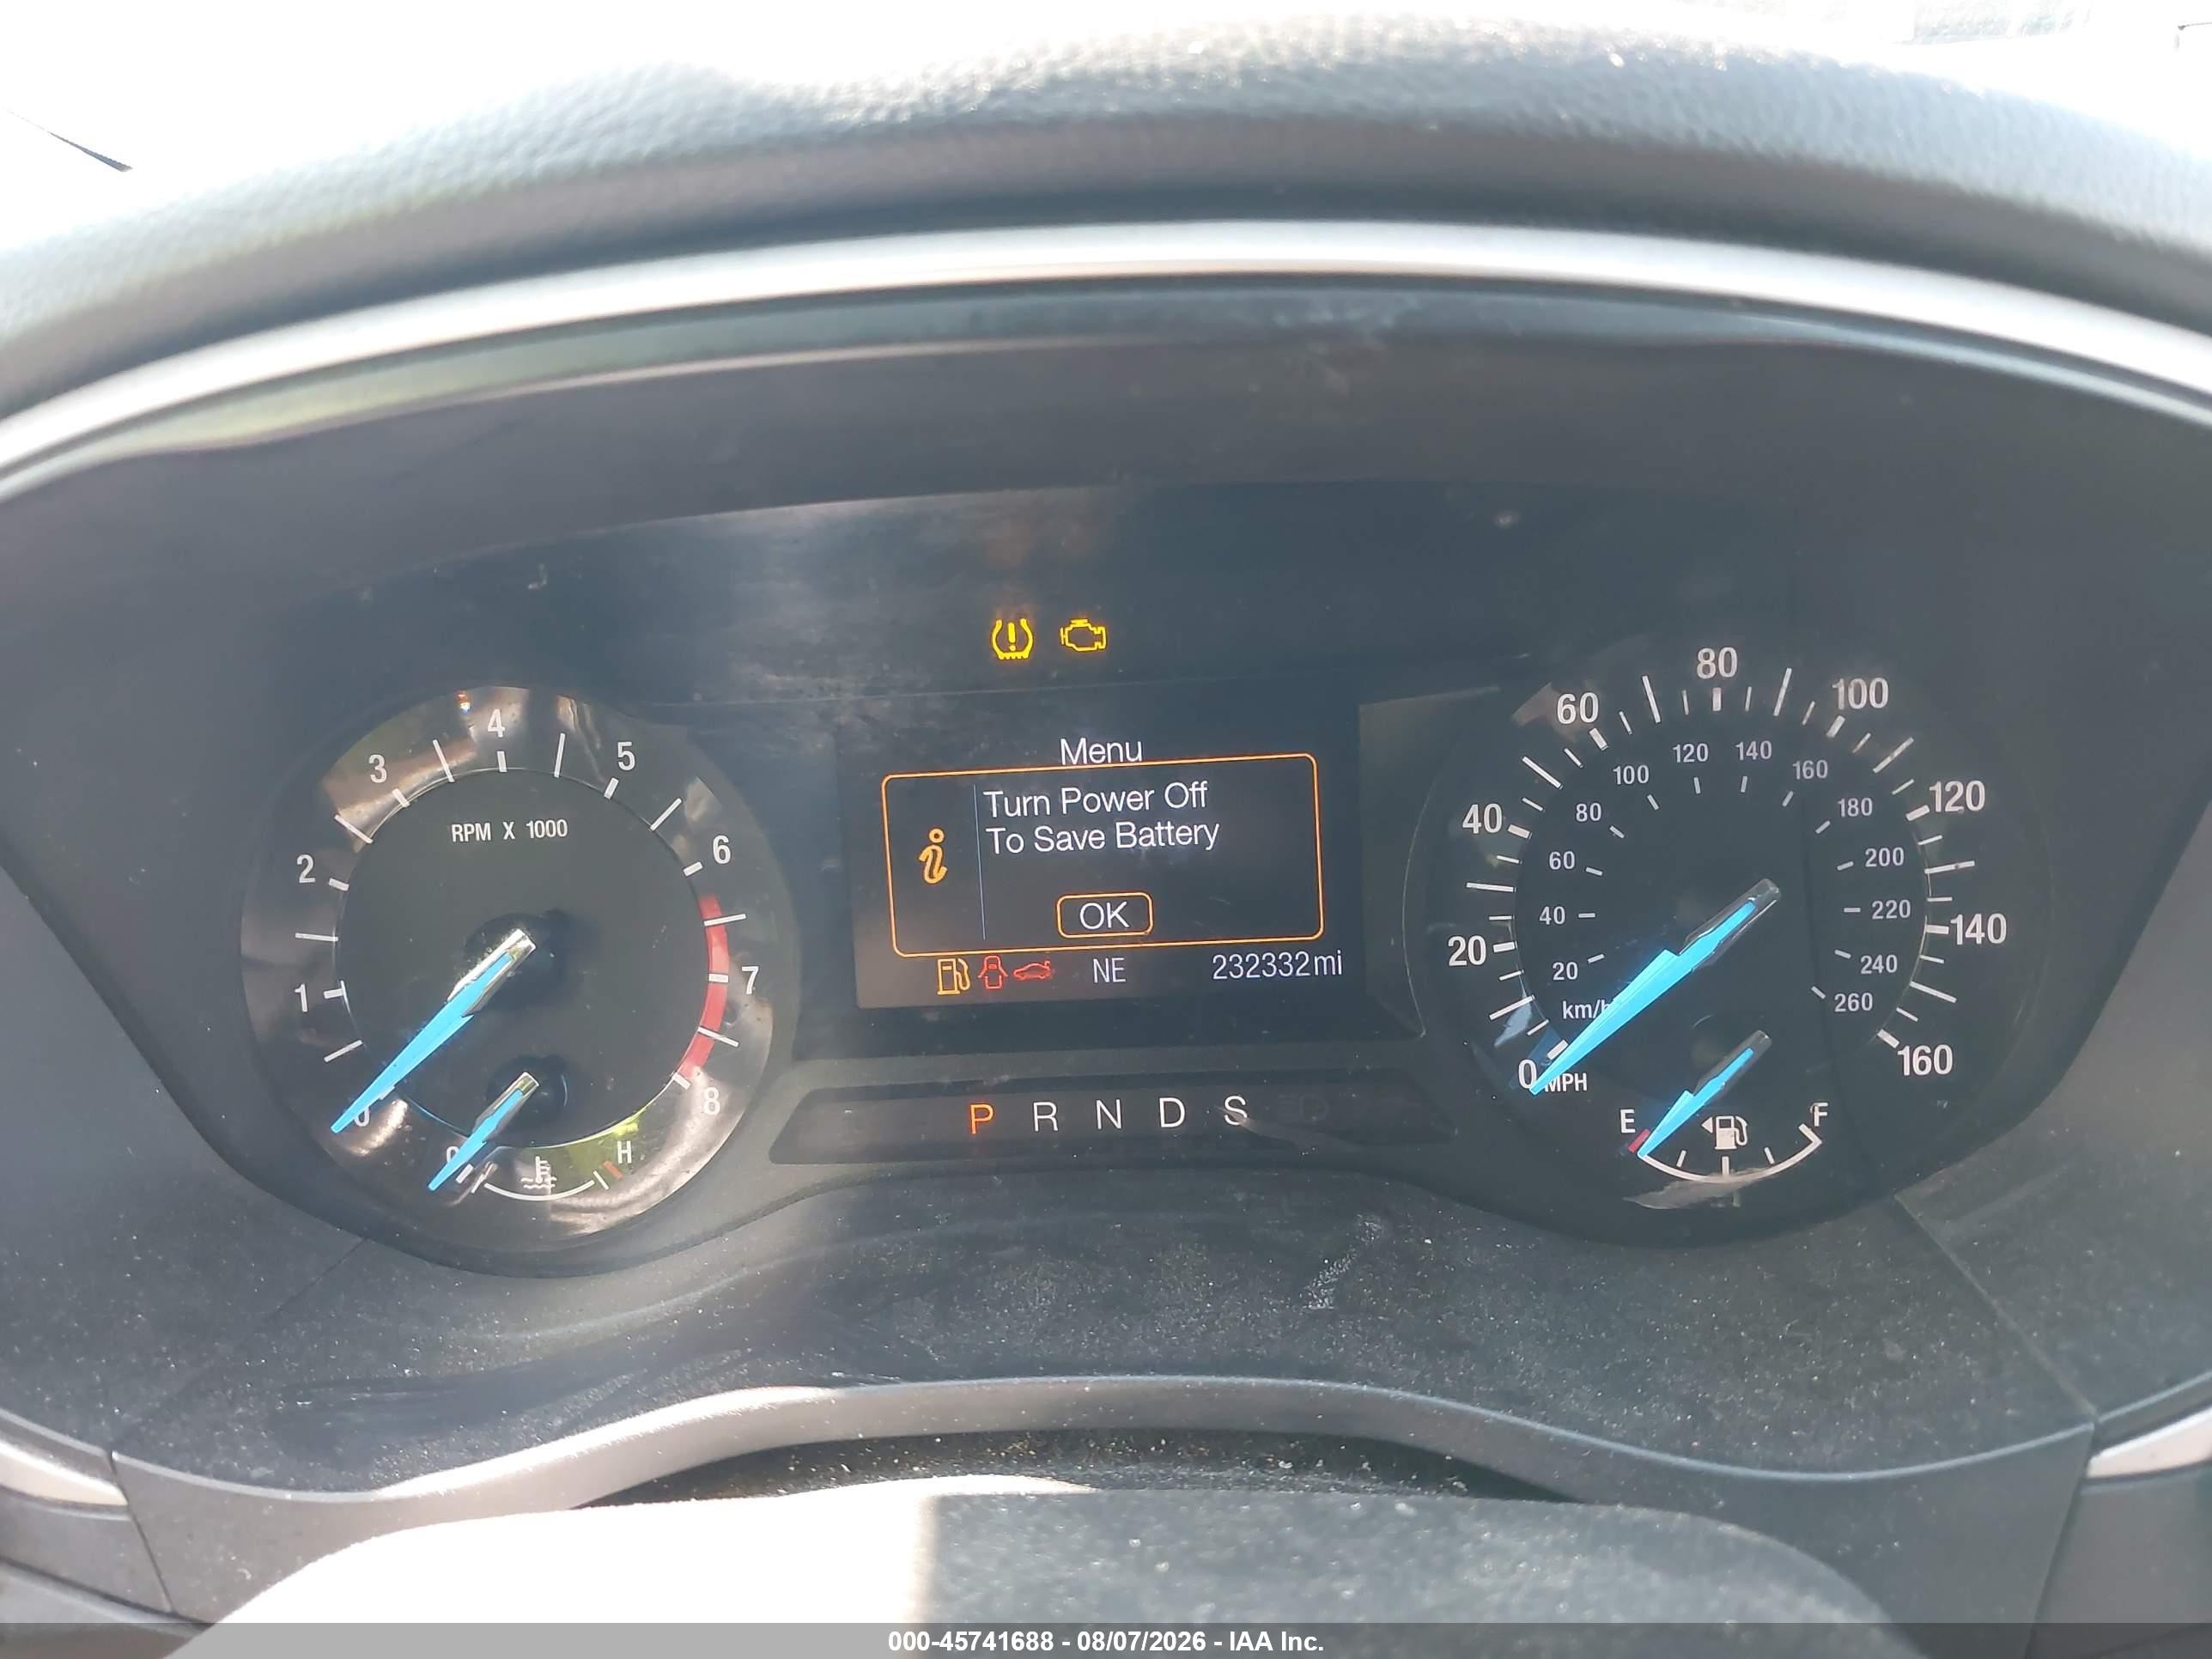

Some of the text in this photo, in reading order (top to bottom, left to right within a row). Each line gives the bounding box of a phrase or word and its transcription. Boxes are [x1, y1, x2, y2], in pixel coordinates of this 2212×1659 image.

[1697, 647, 1738, 679] 80
[1832, 678, 1889, 709] 100
[487, 708, 506, 738] 4
[1557, 692, 1599, 725] 60
[617, 741, 635, 771] 5
[1060, 737, 1142, 764] Menu
[1673, 743, 1709, 763] 120
[1735, 740, 1772, 761] 140
[368, 754, 387, 783] 3
[1613, 764, 1650, 785] 100
[1792, 759, 1828, 780] 160
[982, 780, 1208, 817] Turn Power Off
[1838, 797, 1873, 817] 180
[1928, 780, 1985, 811] 120
[1462, 803, 1503, 834] 40
[1576, 802, 1601, 822] 80
[452, 818, 568, 842] RPM X 1000
[985, 820, 1220, 854] To Save Battery
[713, 835, 731, 865] 6
[1549, 850, 1575, 870] 60
[1865, 847, 1905, 867] 200
[296, 854, 316, 884] 2
[1079, 901, 1130, 930] OK
[1539, 906, 1565, 925] 40
[1872, 899, 1911, 920] 220
[1950, 913, 2007, 945] 140
[1448, 935, 1486, 966] 20
[1860, 954, 1898, 975] 240
[741, 965, 759, 995] 7
[1093, 957, 1126, 983] NE
[1553, 961, 1578, 981] 20
[295, 983, 308, 1012] 1
[1834, 992, 1873, 1012] 260
[1518, 1059, 1537, 1089] 0
[1897, 1044, 1954, 1076] 160
[1545, 1073, 1588, 1092] MPH
[702, 1087, 721, 1116] 8
[969, 1096, 1248, 1134] P R N D S
[1809, 1102, 1828, 1127] F
[1620, 1109, 1636, 1133] E
[617, 1140, 632, 1164] H
